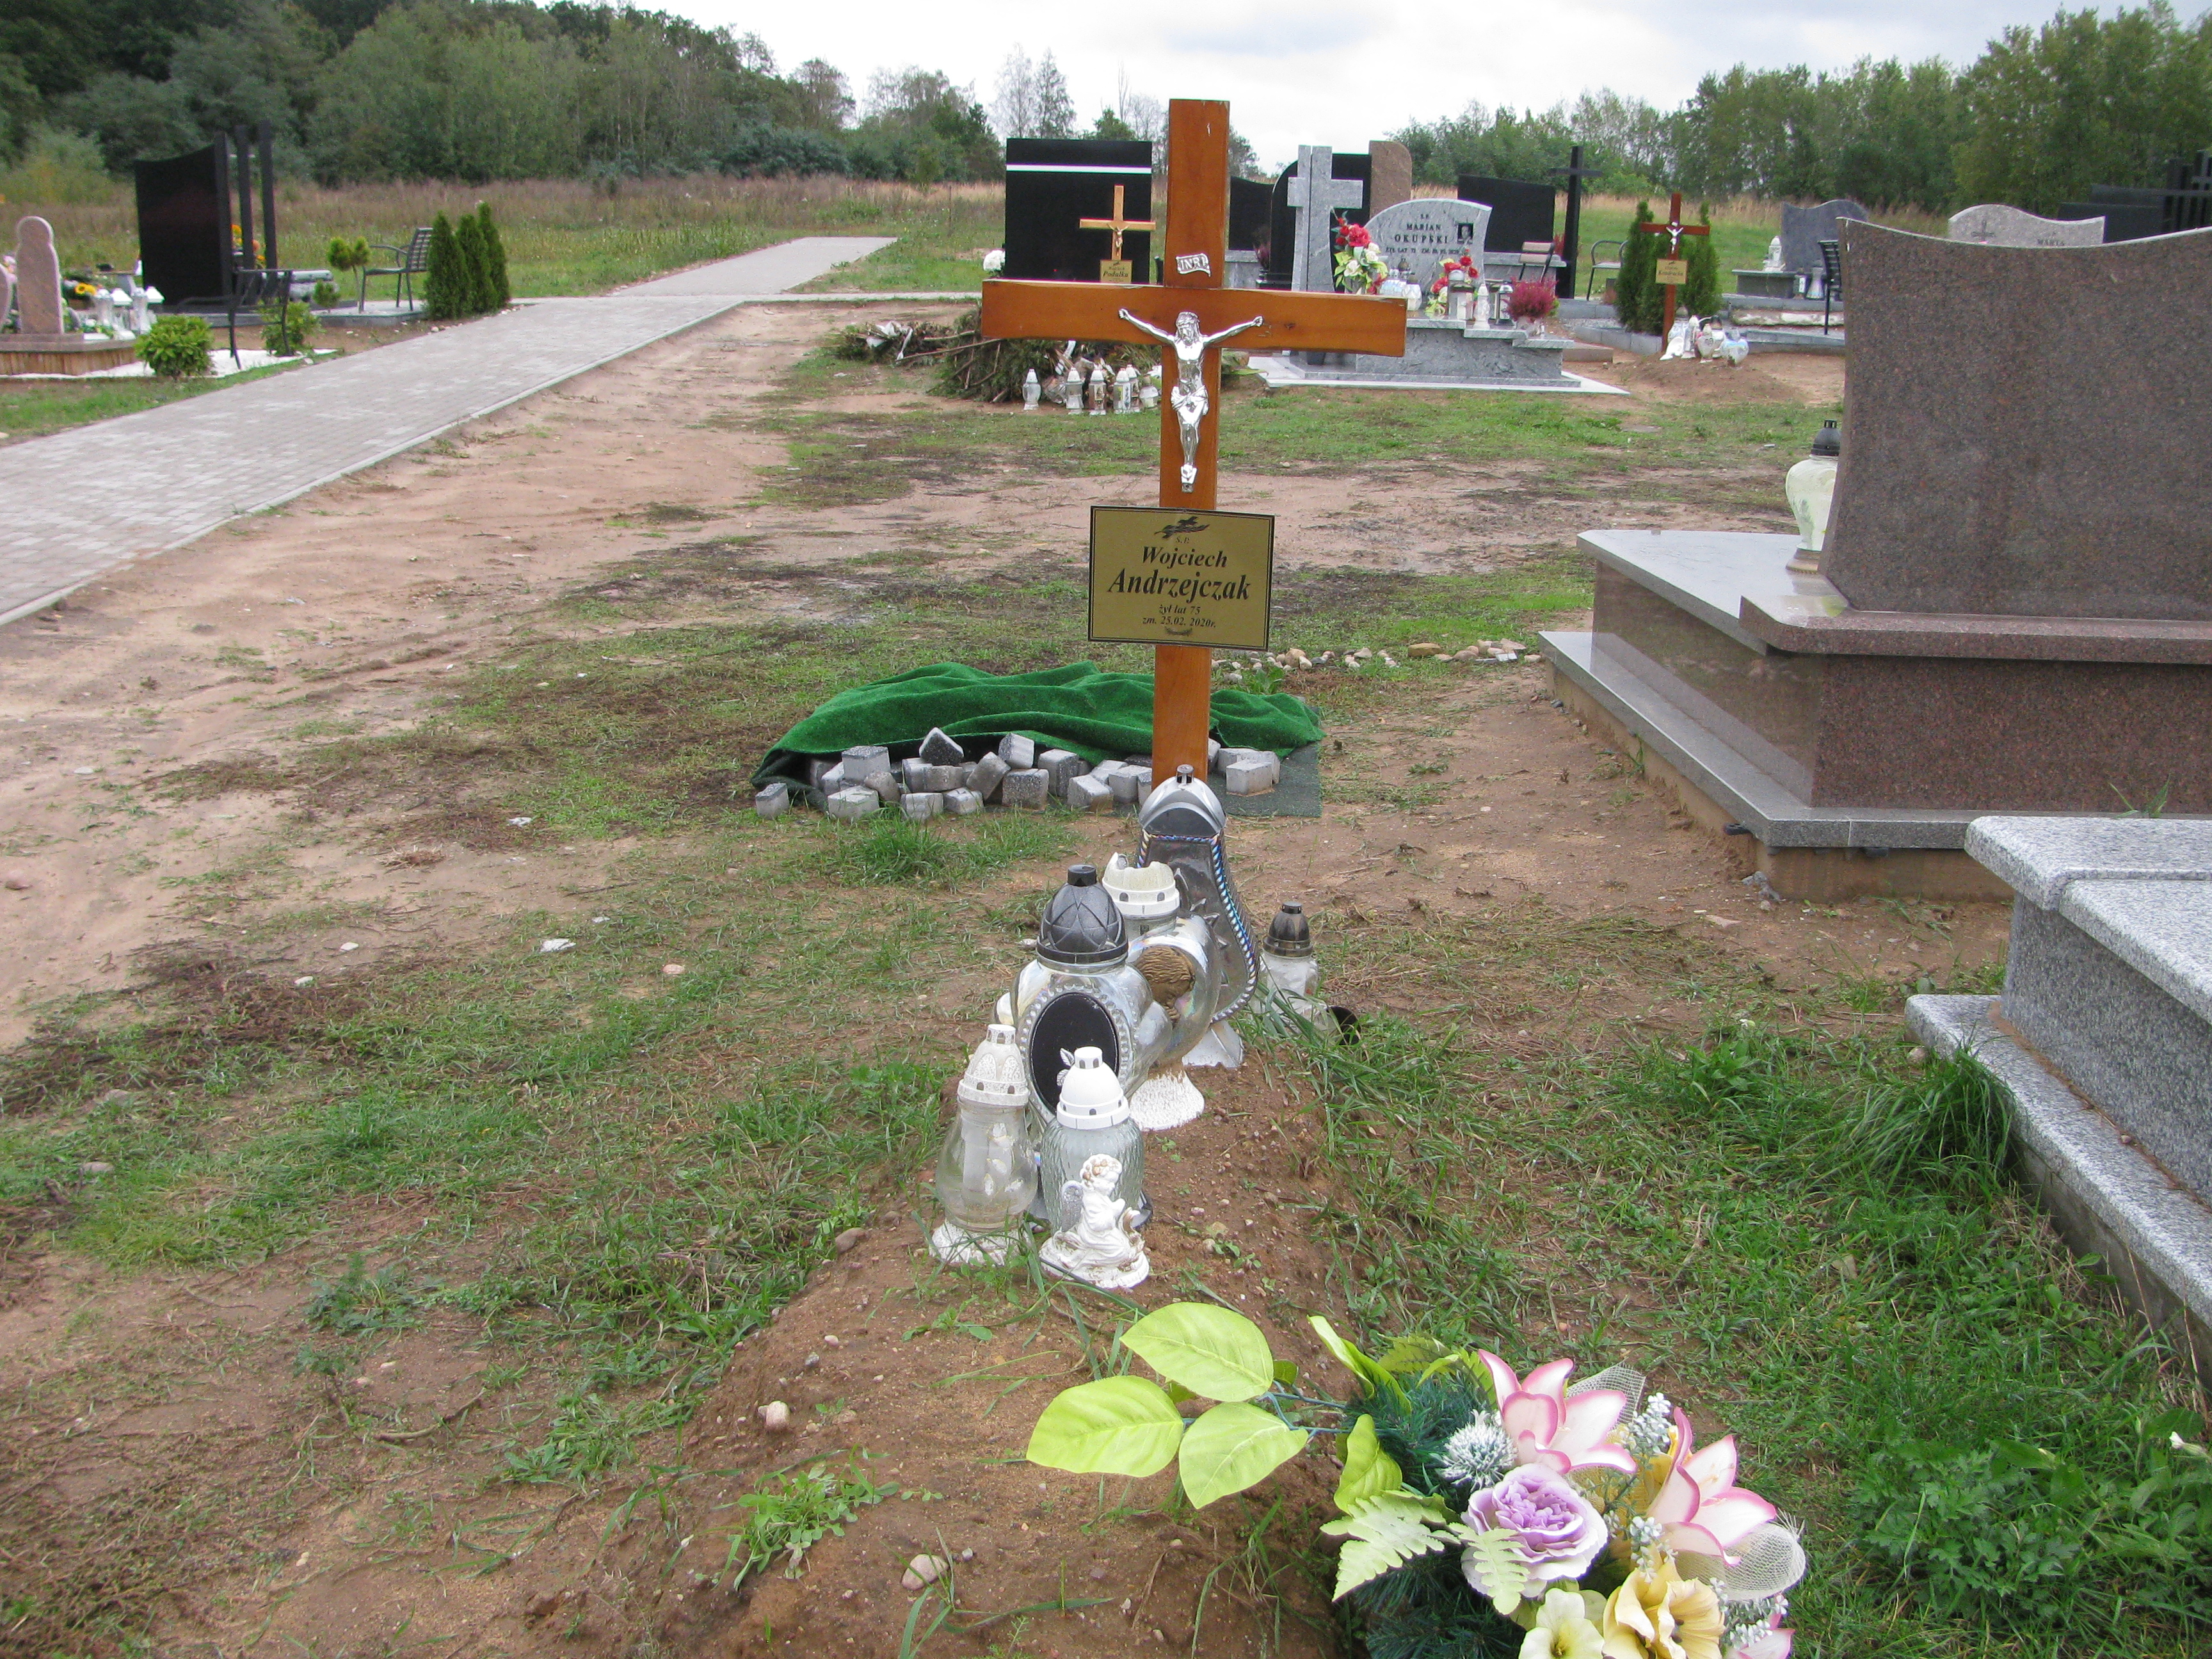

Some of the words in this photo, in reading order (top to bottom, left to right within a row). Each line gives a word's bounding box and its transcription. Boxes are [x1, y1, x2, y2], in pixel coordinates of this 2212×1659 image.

[1395, 234, 1448, 243] OKUPSKI
[1180, 256, 1206, 269] INRI
[1142, 546, 1228, 569] Wojciech
[1107, 568, 1251, 603] Andrzejczak
[1174, 605, 1187, 614] lat
[1191, 605, 1201, 614] 75
